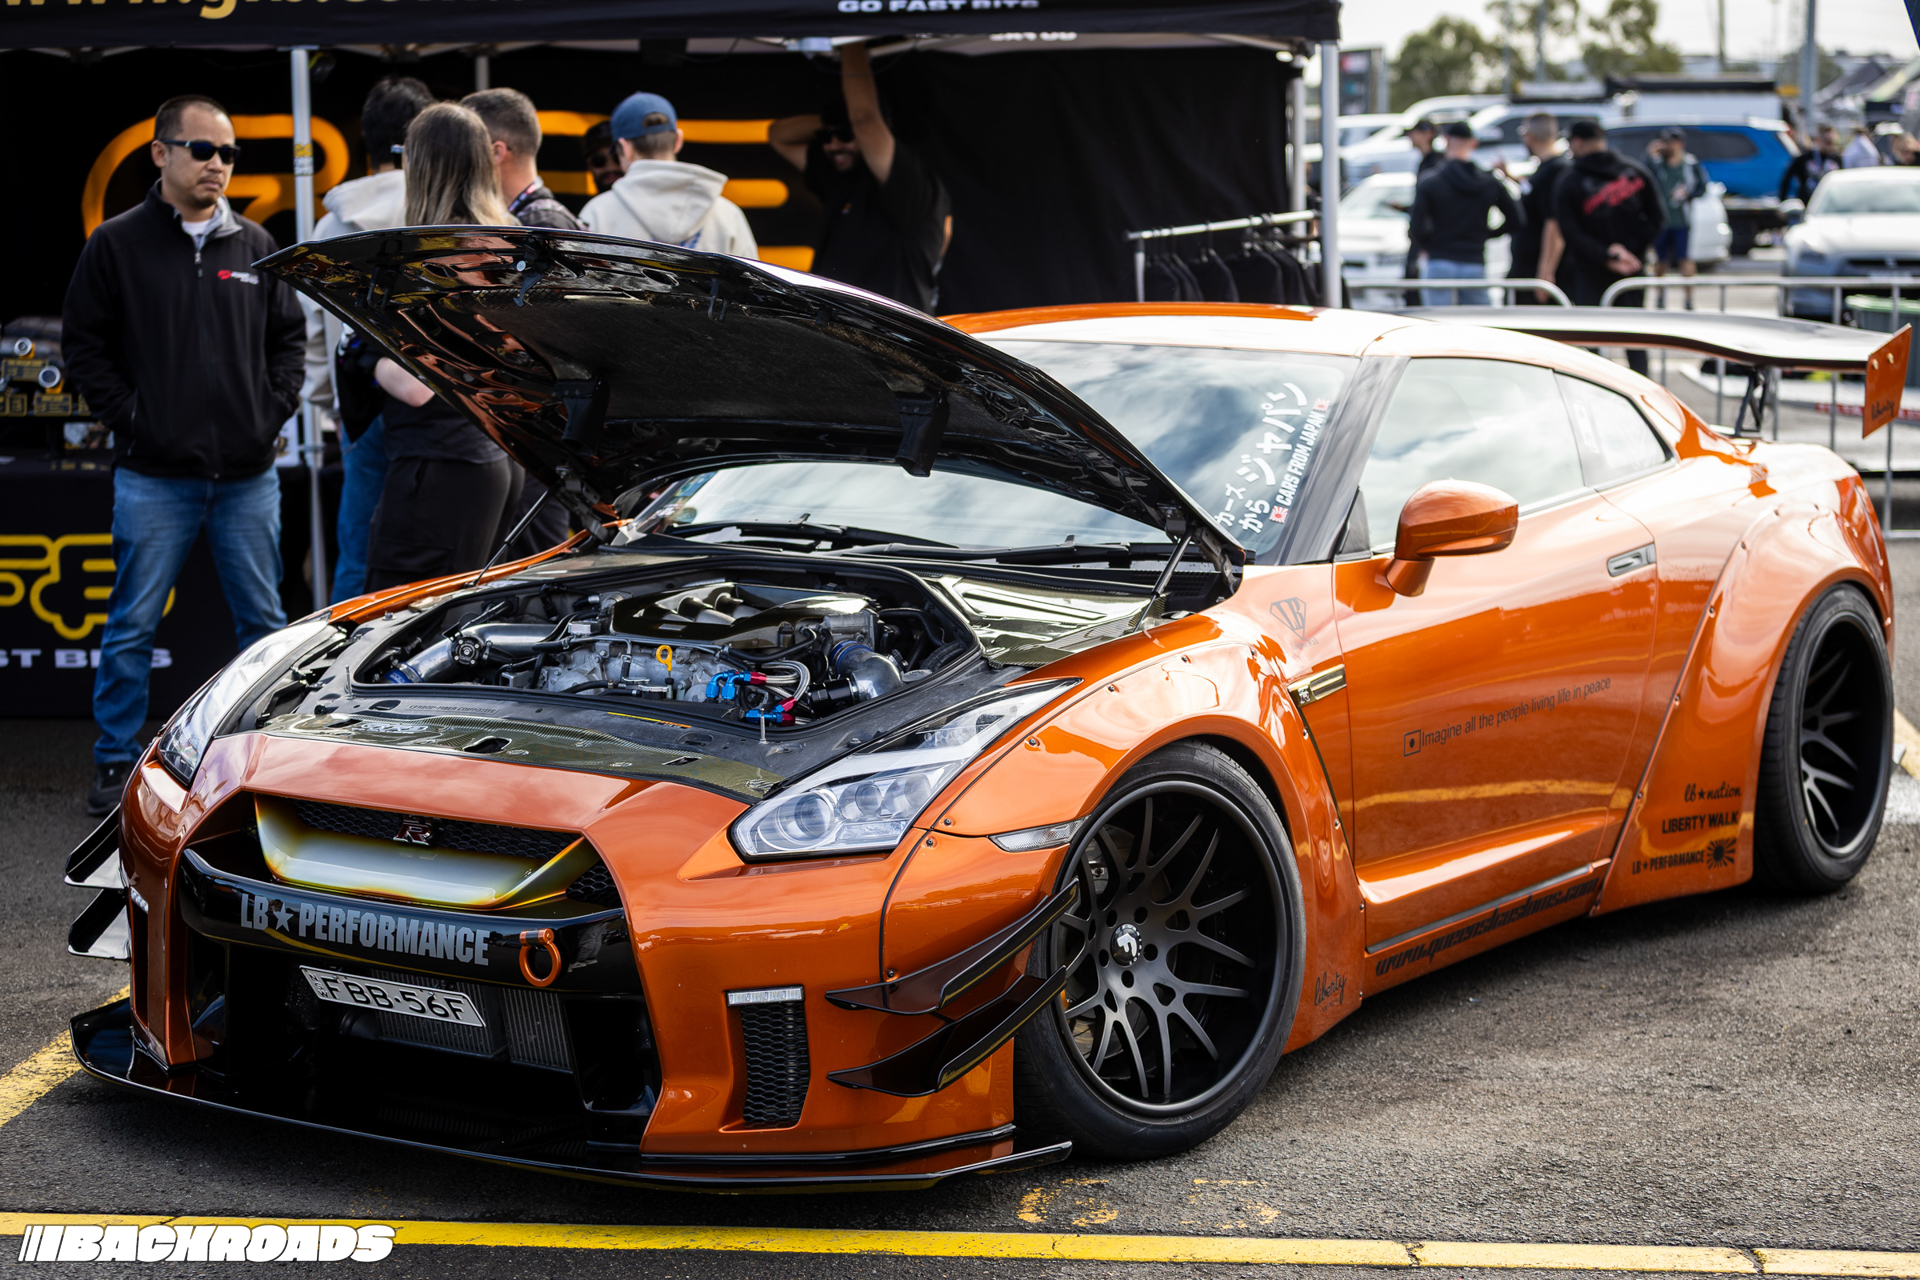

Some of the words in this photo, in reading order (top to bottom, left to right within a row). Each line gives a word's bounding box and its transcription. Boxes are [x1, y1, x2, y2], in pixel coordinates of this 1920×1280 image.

[838, 0, 883, 12] GO
[889, 0, 966, 11] FAST
[1299, 410, 1326, 446] JAPAN
[1287, 443, 1312, 476] FROM
[1275, 473, 1301, 507] CARS
[55, 648, 173, 669] BIS
[1421, 724, 1462, 747] Imagine
[1464, 716, 1476, 734] all
[1479, 713, 1494, 730] the
[1496, 701, 1529, 728] people
[1531, 693, 1555, 712] living
[1557, 687, 1571, 705] life
[1573, 684, 1582, 699] in
[1583, 677, 1611, 700] peace
[1662, 814, 1706, 835] LIBERTY
[1708, 811, 1739, 829] WALK
[241, 893, 269, 931] LB
[299, 902, 490, 966] PERFORMANCE
